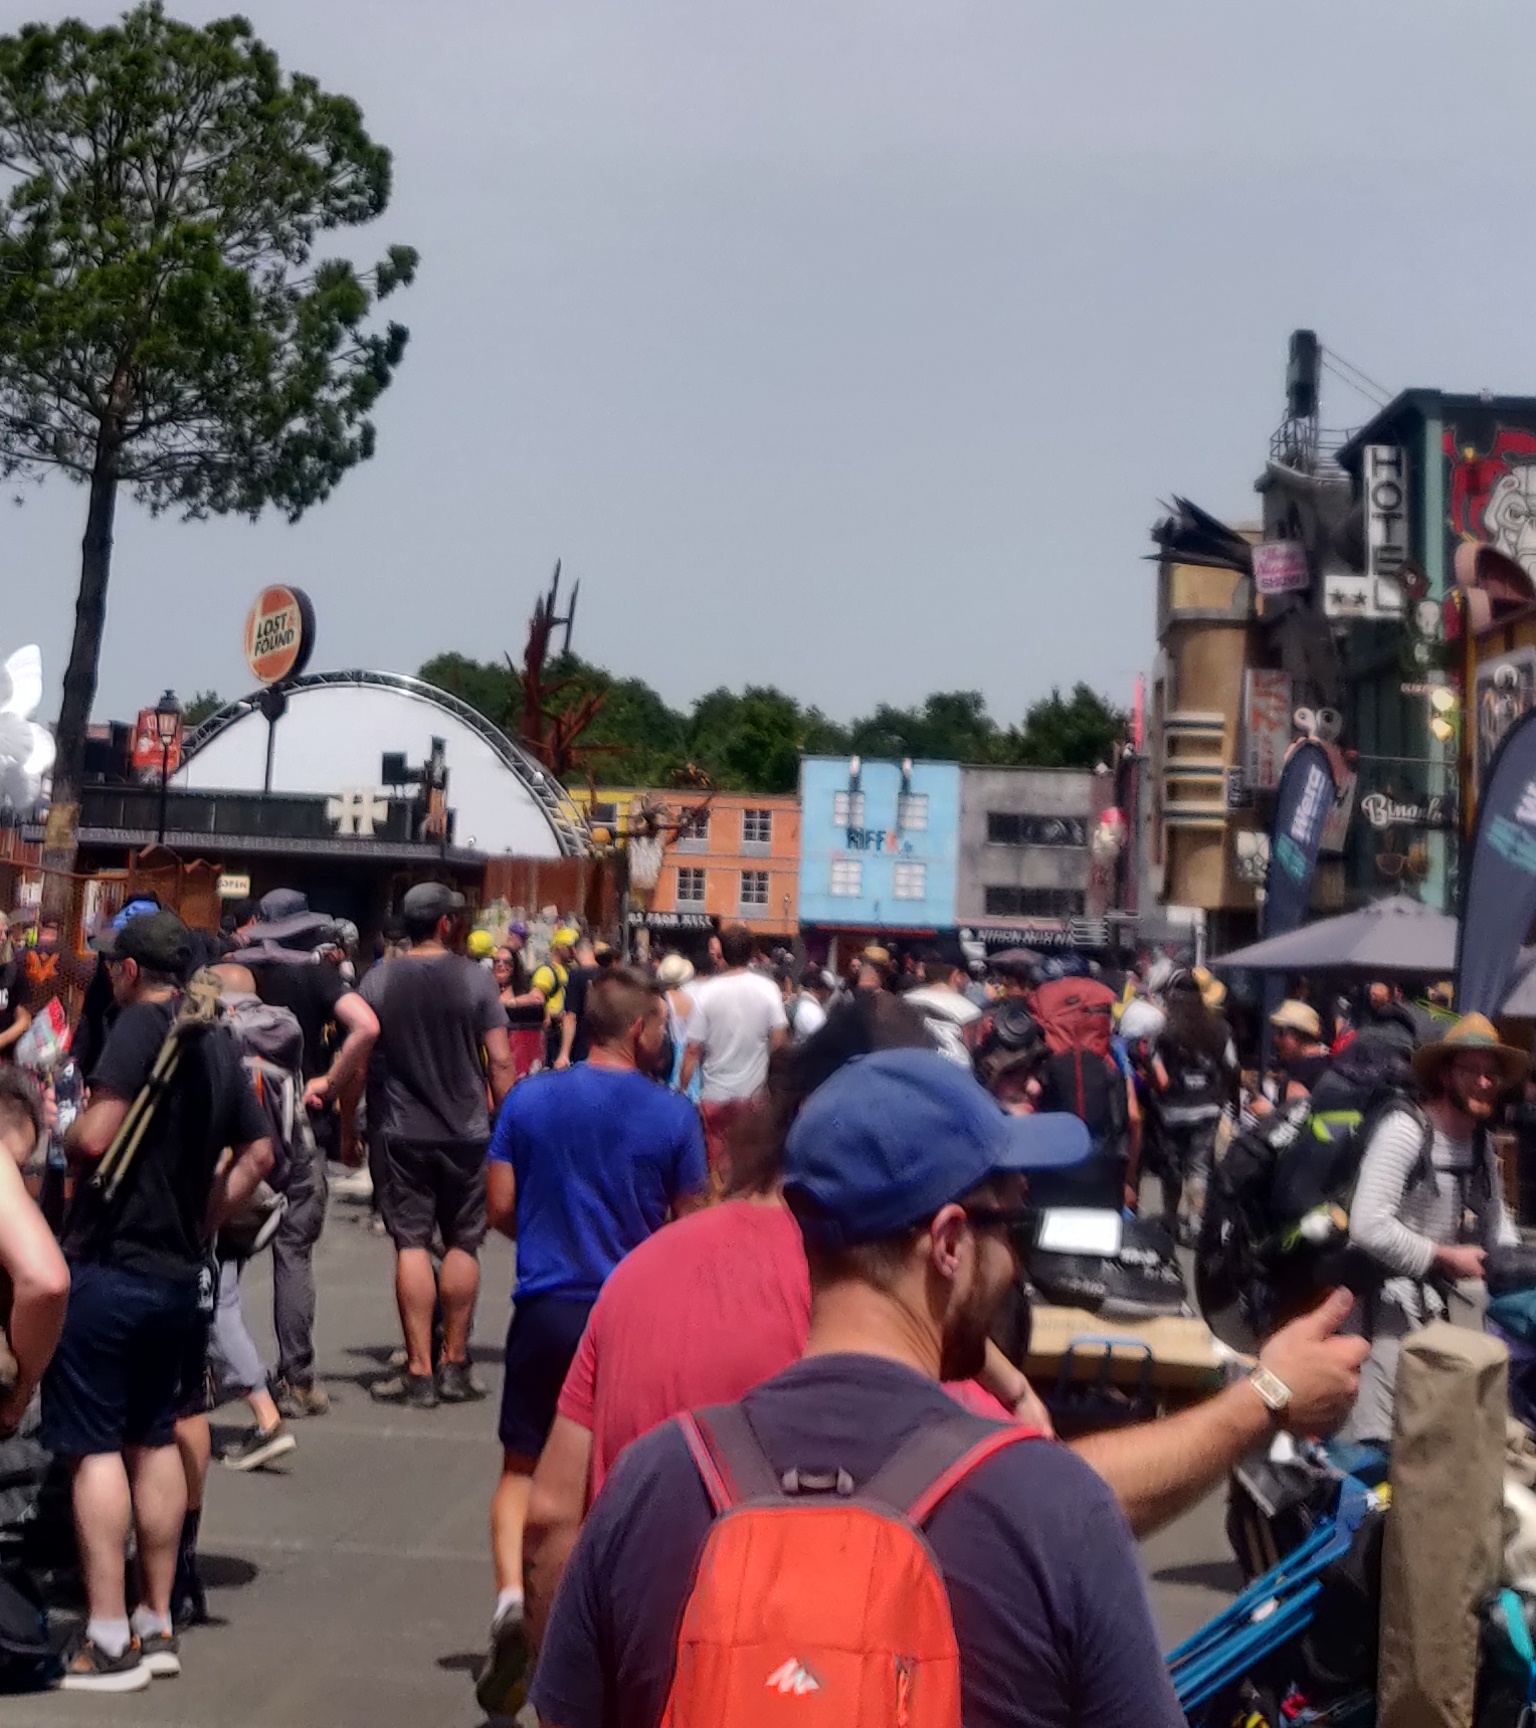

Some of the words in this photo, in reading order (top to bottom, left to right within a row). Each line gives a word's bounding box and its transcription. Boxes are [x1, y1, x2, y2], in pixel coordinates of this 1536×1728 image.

[1371, 447, 1405, 612] HOTEL
[256, 612, 288, 640] LOST
[254, 627, 295, 657] FOUND
